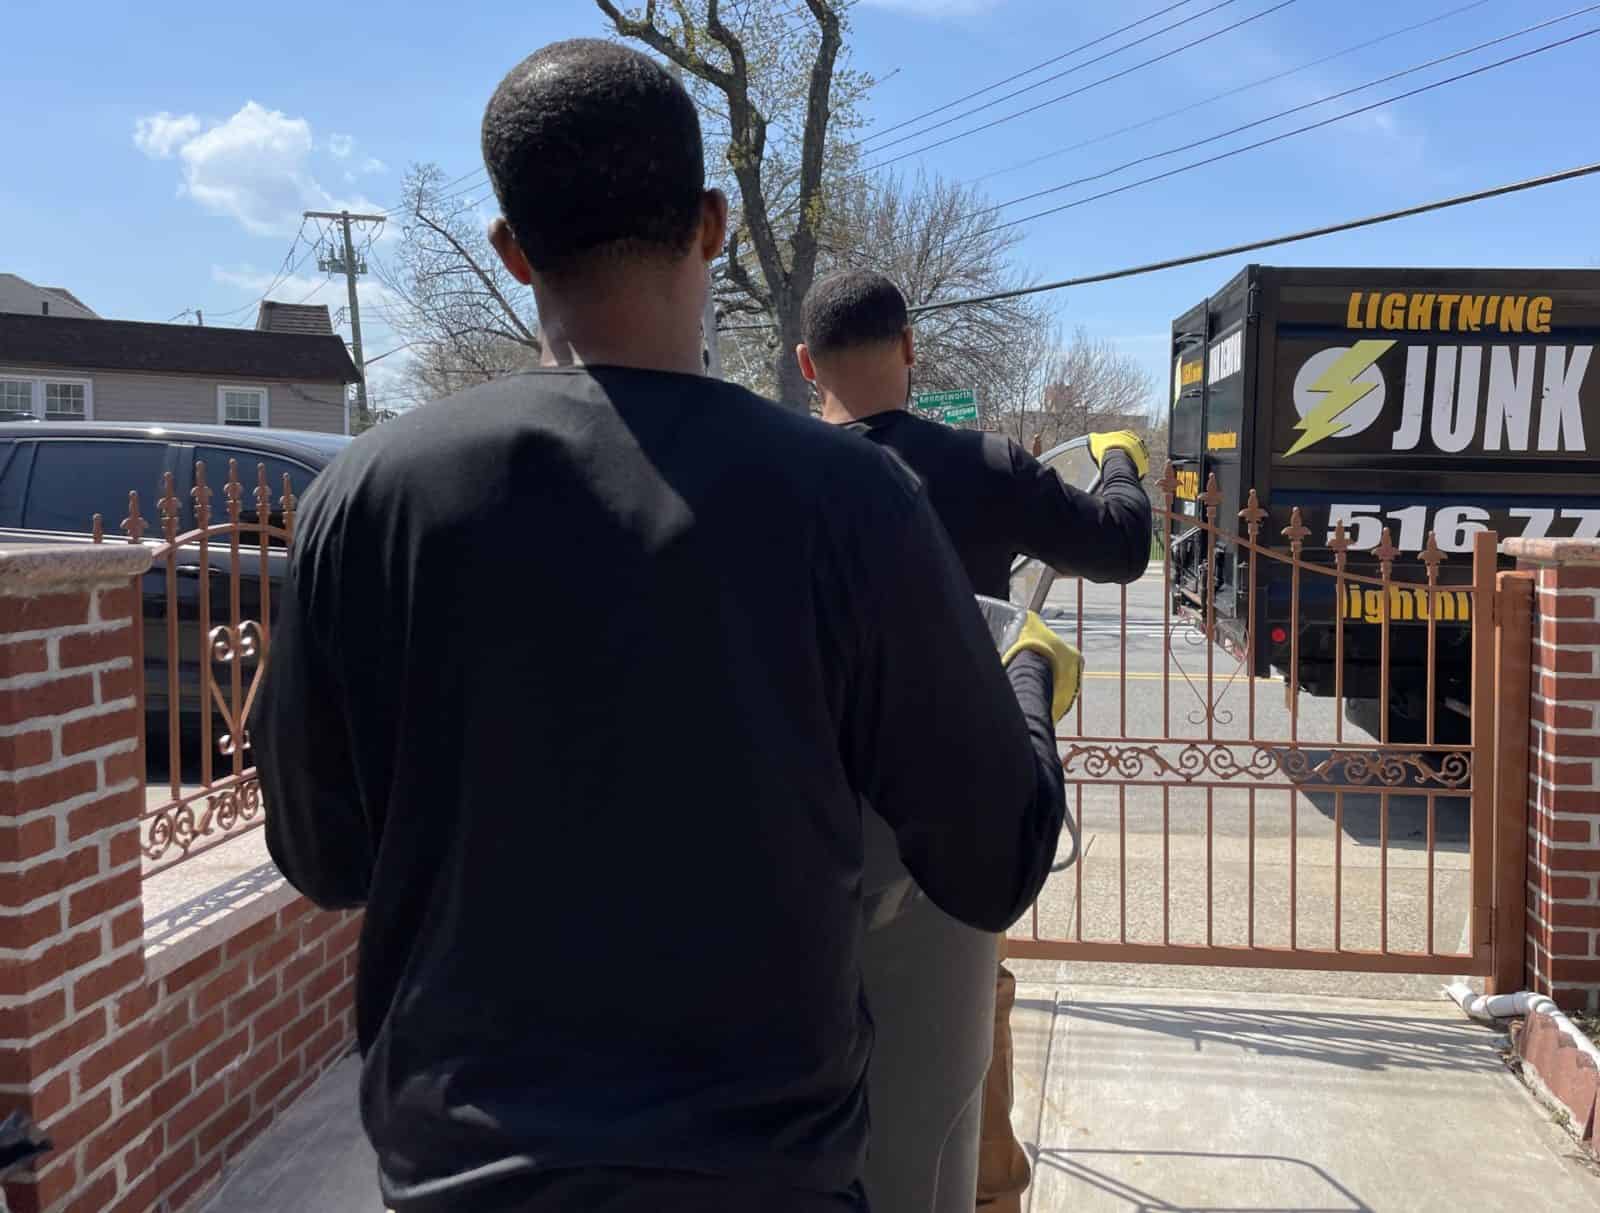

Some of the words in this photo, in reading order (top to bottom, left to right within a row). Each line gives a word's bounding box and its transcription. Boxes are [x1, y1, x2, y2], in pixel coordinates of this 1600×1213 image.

[1347, 291, 1553, 334] LIGHTNING
[1391, 345, 1594, 453] JUNK
[1326, 503, 1491, 553] 516
